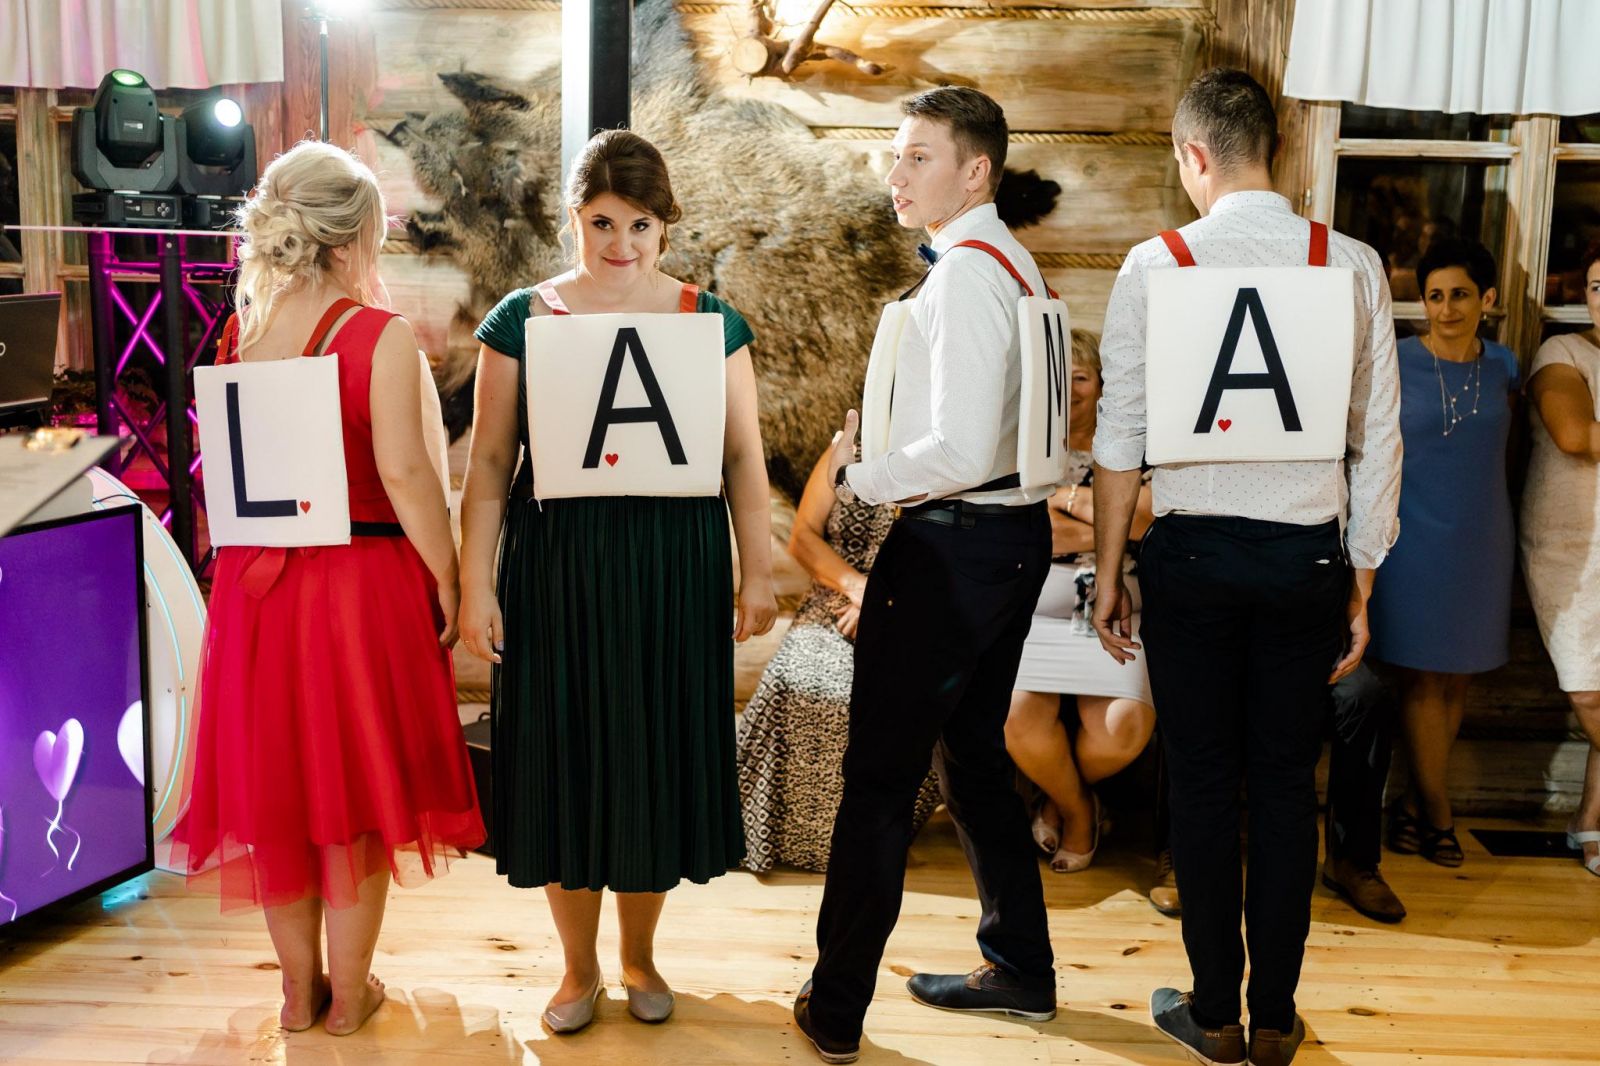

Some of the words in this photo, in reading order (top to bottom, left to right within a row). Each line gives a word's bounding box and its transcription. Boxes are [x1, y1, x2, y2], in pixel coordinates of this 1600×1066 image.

[582, 328, 689, 469] A
[1043, 313, 1067, 458] M
[1193, 287, 1303, 433] A
[225, 382, 298, 518] L
